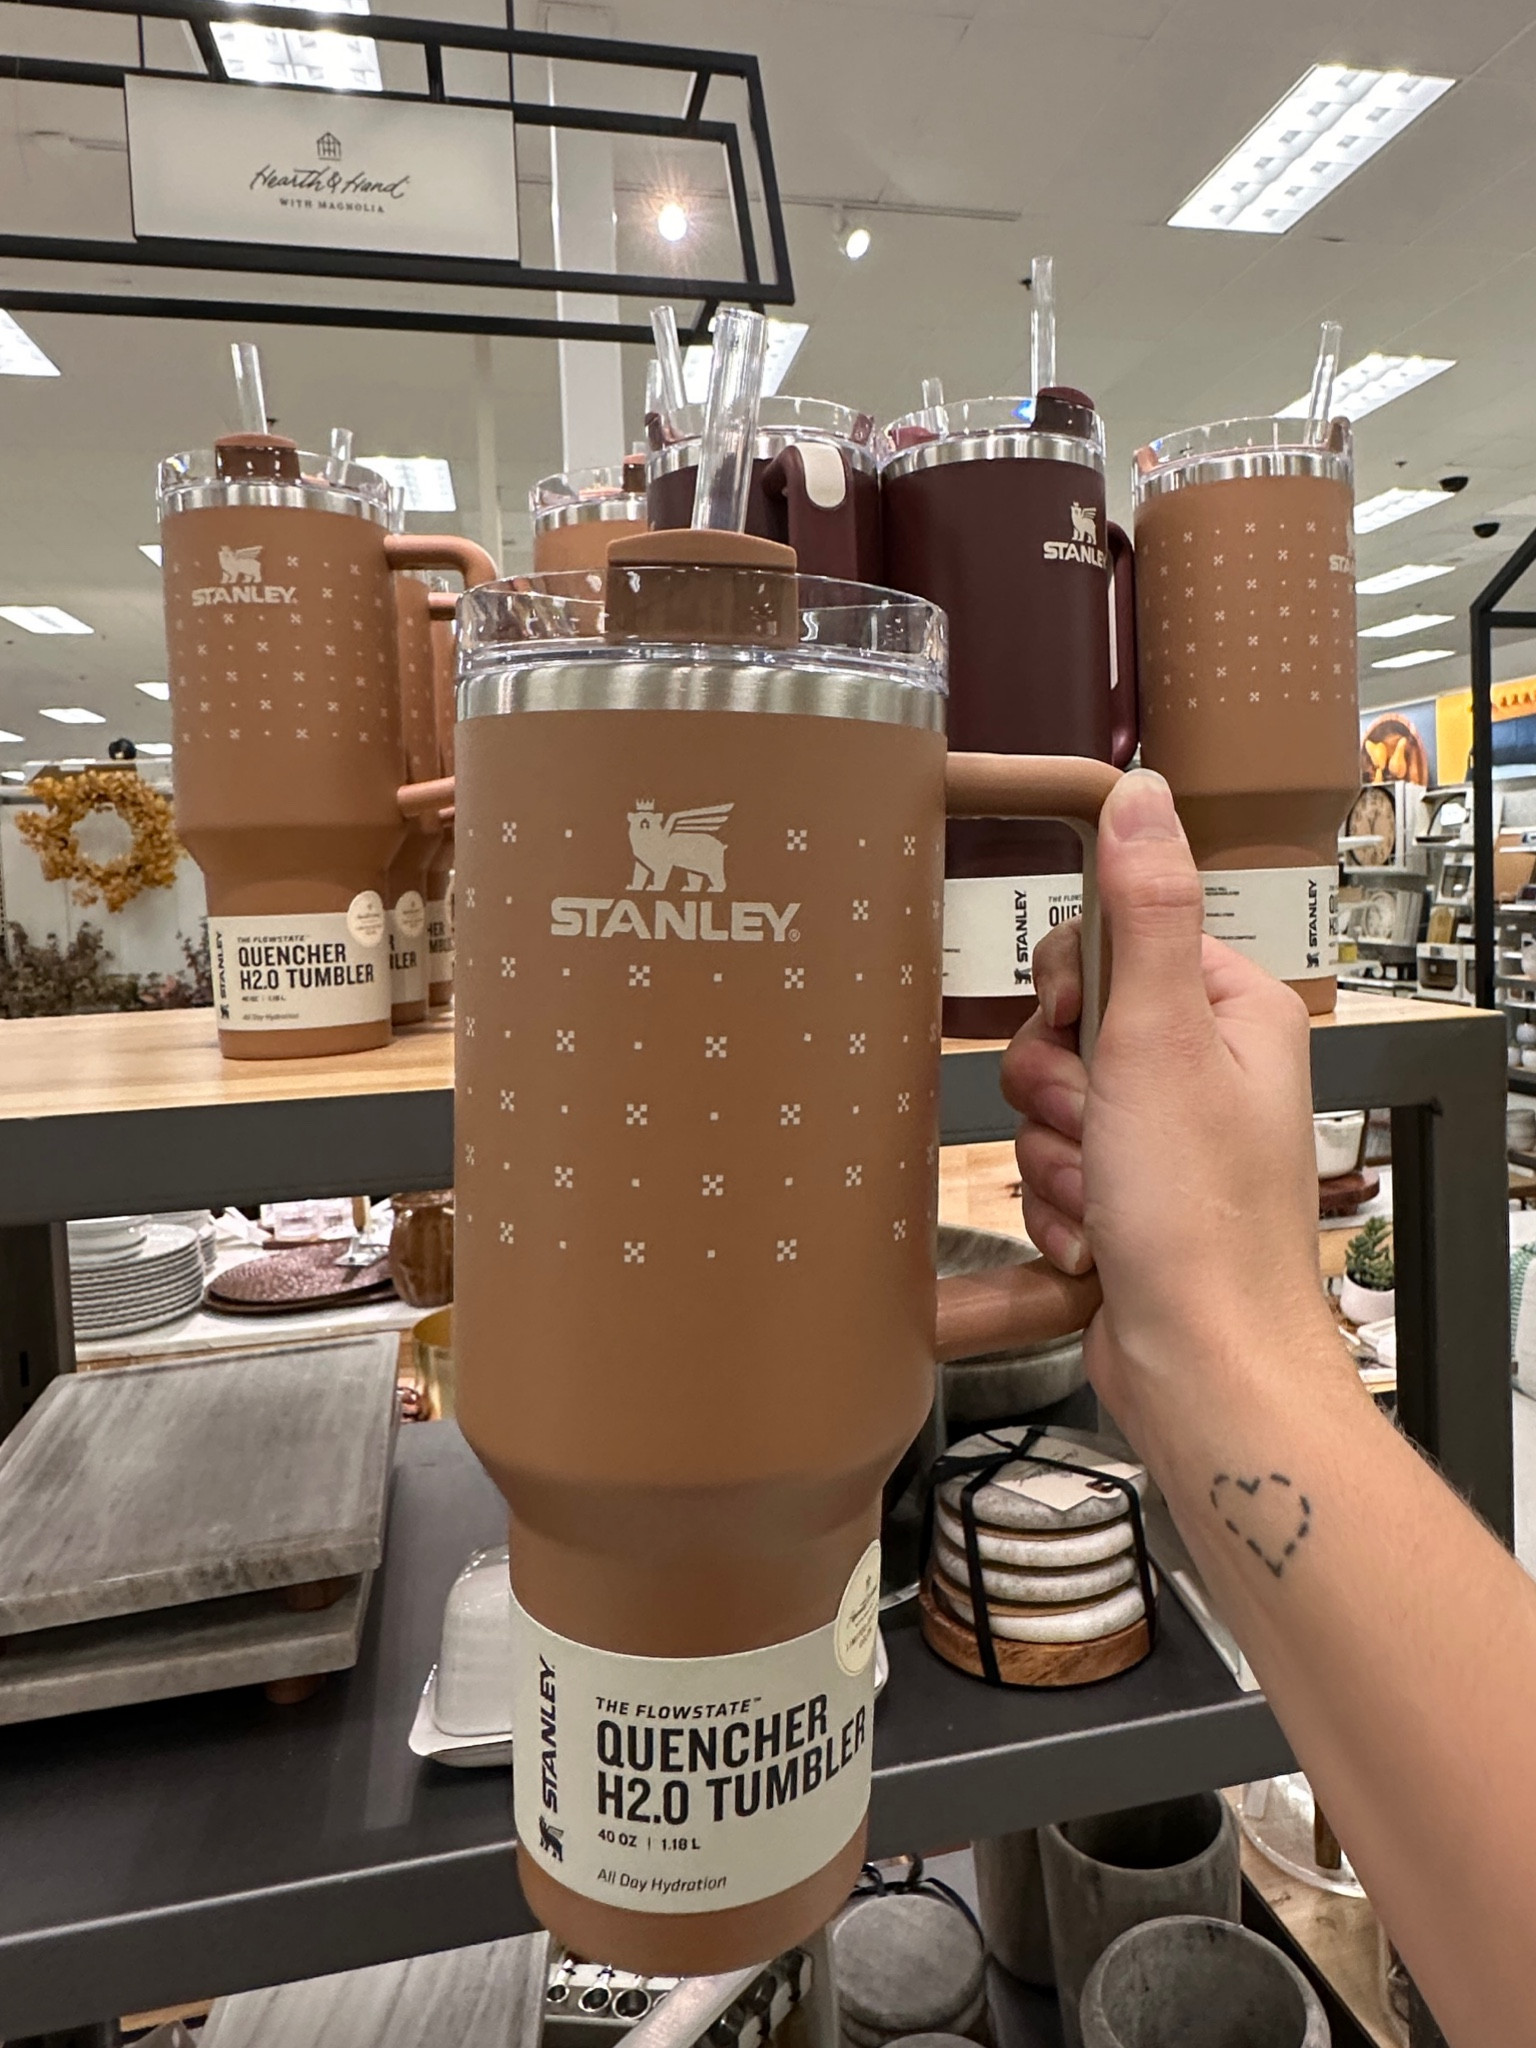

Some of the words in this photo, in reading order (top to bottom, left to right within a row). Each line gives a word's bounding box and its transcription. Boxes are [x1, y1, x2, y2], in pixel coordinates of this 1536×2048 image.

[250, 164, 330, 191] Hearth
[327, 171, 342, 194] &
[340, 171, 410, 199] Hand
[279, 198, 313, 208] WITH
[318, 200, 385, 213] MAGNOLIA
[1014, 890, 1028, 963] STANLEY
[1308, 879, 1318, 948] STANLEY
[216, 931, 228, 999] STANLEY
[238, 943, 347, 967] QUENCHER
[286, 963, 375, 989] TUMBLER
[595, 1697, 630, 1716] THE
[539, 1653, 558, 1814] STANLEY
[596, 1693, 829, 1773] QUENCHER
[706, 1704, 867, 1823] TUMBLER
[598, 1829, 616, 1845] 40
[618, 1832, 638, 1848] OZ
[661, 1838, 688, 1851] 1.18
[691, 1838, 701, 1850] L
[596, 1868, 616, 1885] All
[620, 1873, 647, 1893] Day
[651, 1876, 728, 1895] Hydration
